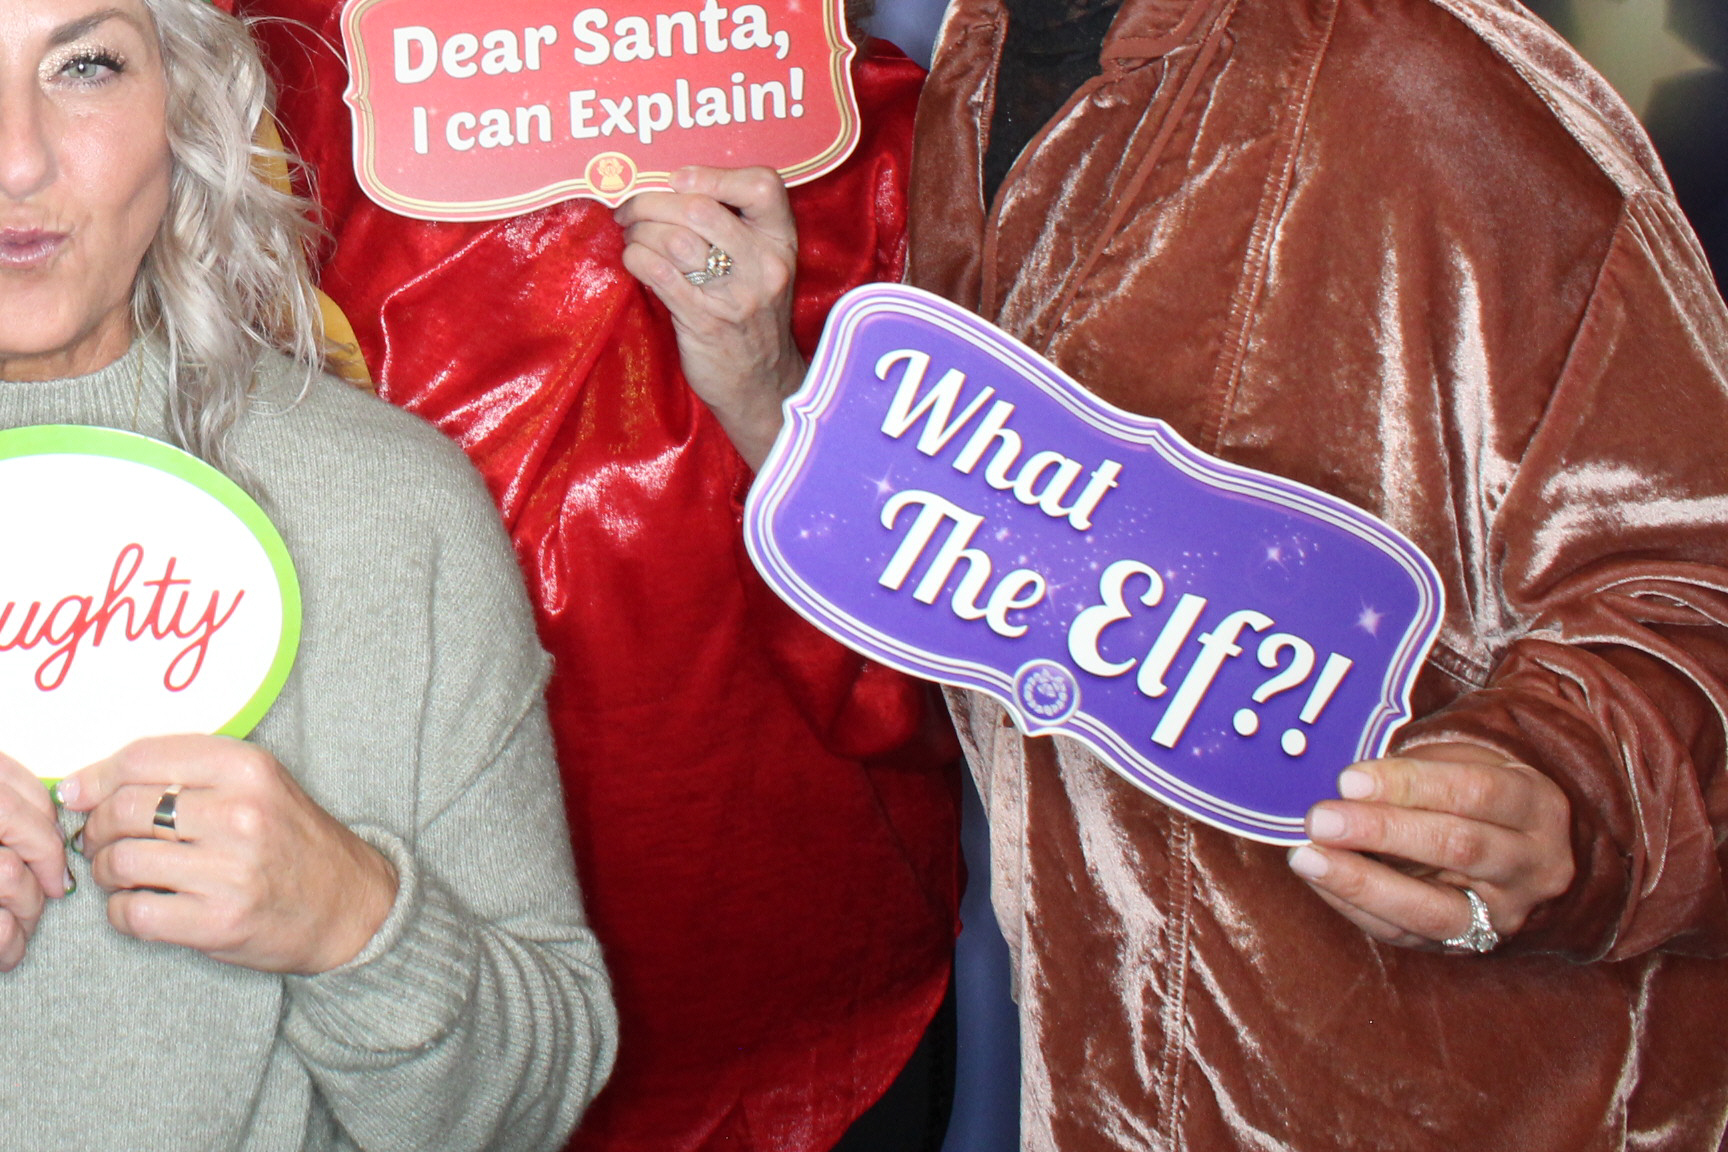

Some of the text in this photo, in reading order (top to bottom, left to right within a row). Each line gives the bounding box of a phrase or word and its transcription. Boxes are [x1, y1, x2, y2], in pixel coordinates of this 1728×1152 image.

[393, 24, 558, 84] Dear
[412, 67, 806, 154] I can Explain!
[874, 348, 1123, 531] What
[878, 489, 1353, 757] The Elf?!
